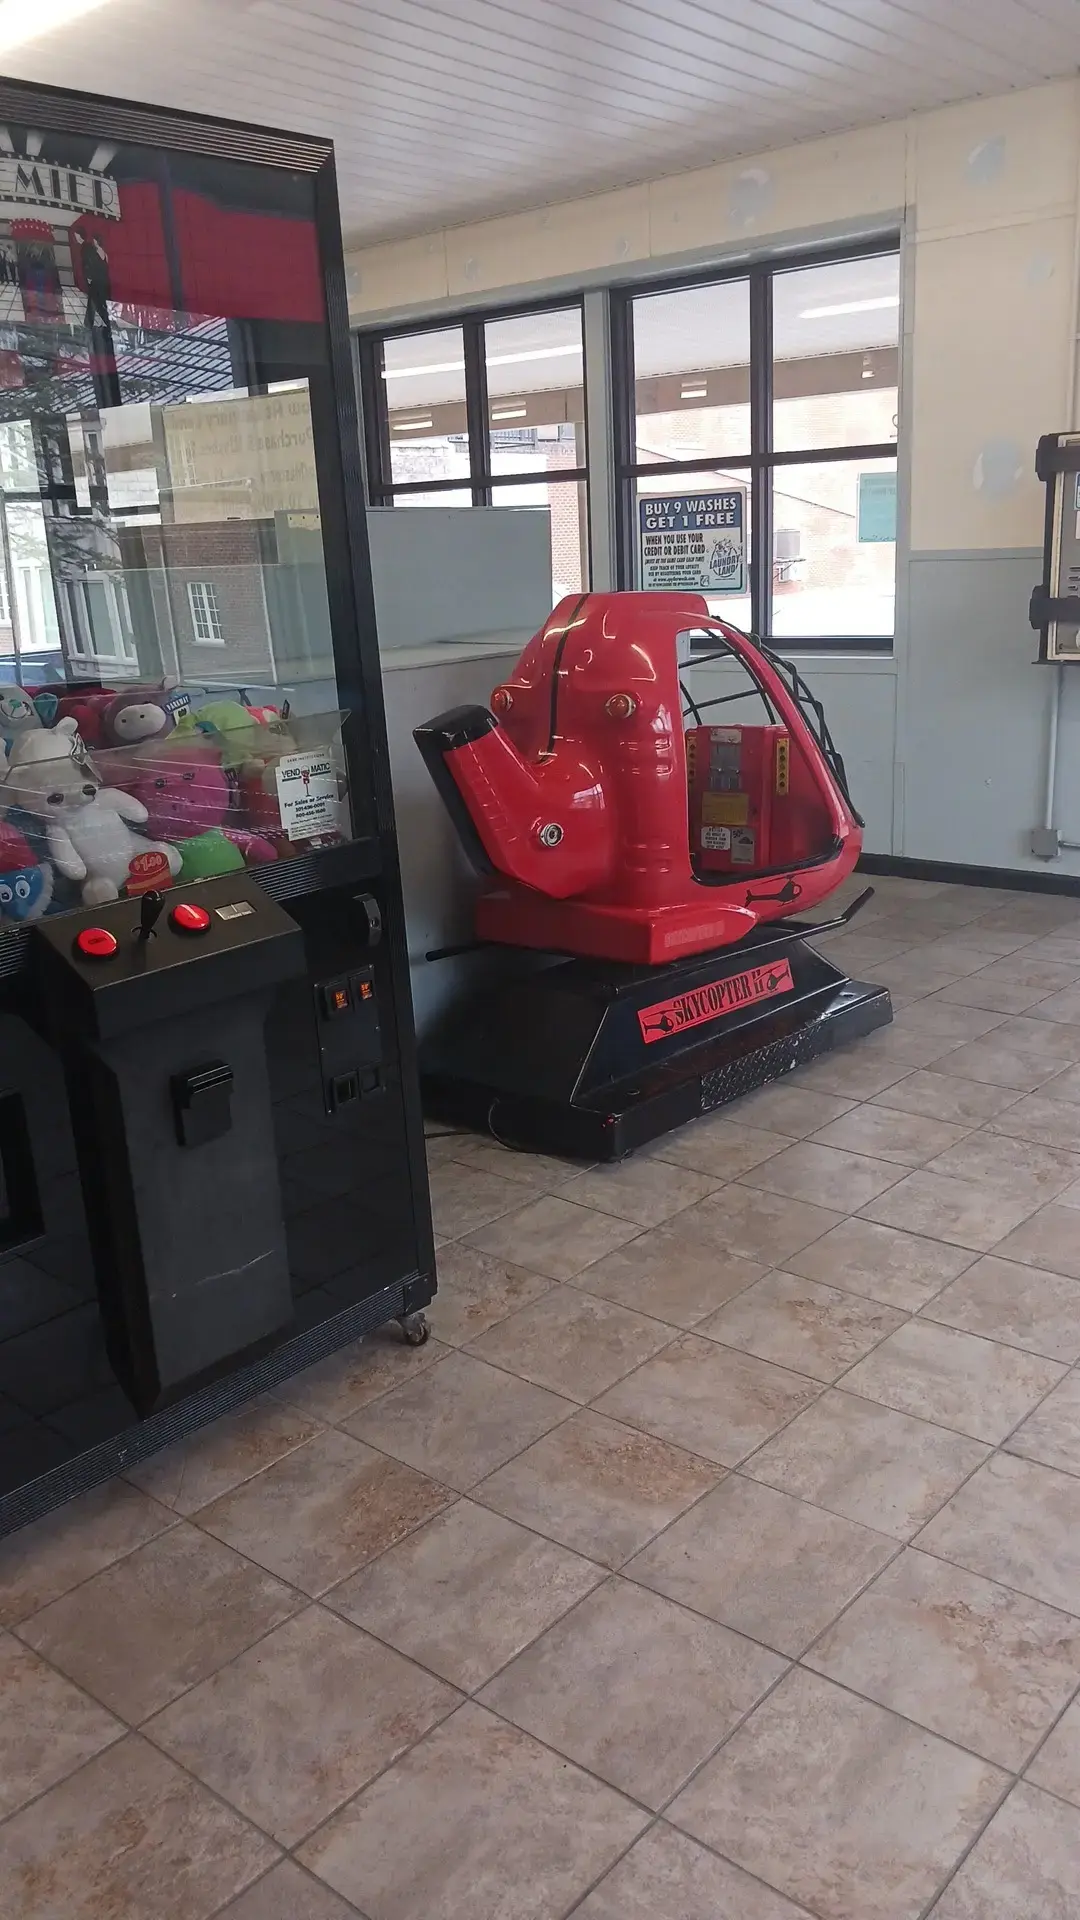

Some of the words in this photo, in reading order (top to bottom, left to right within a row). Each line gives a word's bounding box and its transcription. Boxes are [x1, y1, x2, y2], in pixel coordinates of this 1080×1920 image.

[645, 502, 670, 516] BUY
[673, 501, 682, 513] 9
[686, 497, 737, 513] WASHES
[645, 515, 676, 529] GET
[682, 515, 688, 527] 1
[696, 512, 734, 526] FREE
[645, 535, 662, 545] WHEN
[663, 534, 675, 544] YOU
[676, 533, 686, 543] USE
[687, 532, 703, 543] YOUR
[644, 546, 663, 556] CREDIT
[663, 546, 672, 555] OR
[673, 545, 689, 555] DEBIT
[690, 544, 706, 554] CARD
[709, 553, 740, 570] LAUNDRY
[718, 564, 736, 576] LAND
[281, 768, 300, 779] VEND
[310, 762, 331, 773] MATIC
[294, 799, 308, 807] Sales
[316, 793, 334, 801] Service
[672, 973, 753, 1026] SKYCOPTER
[752, 969, 764, 994] II
